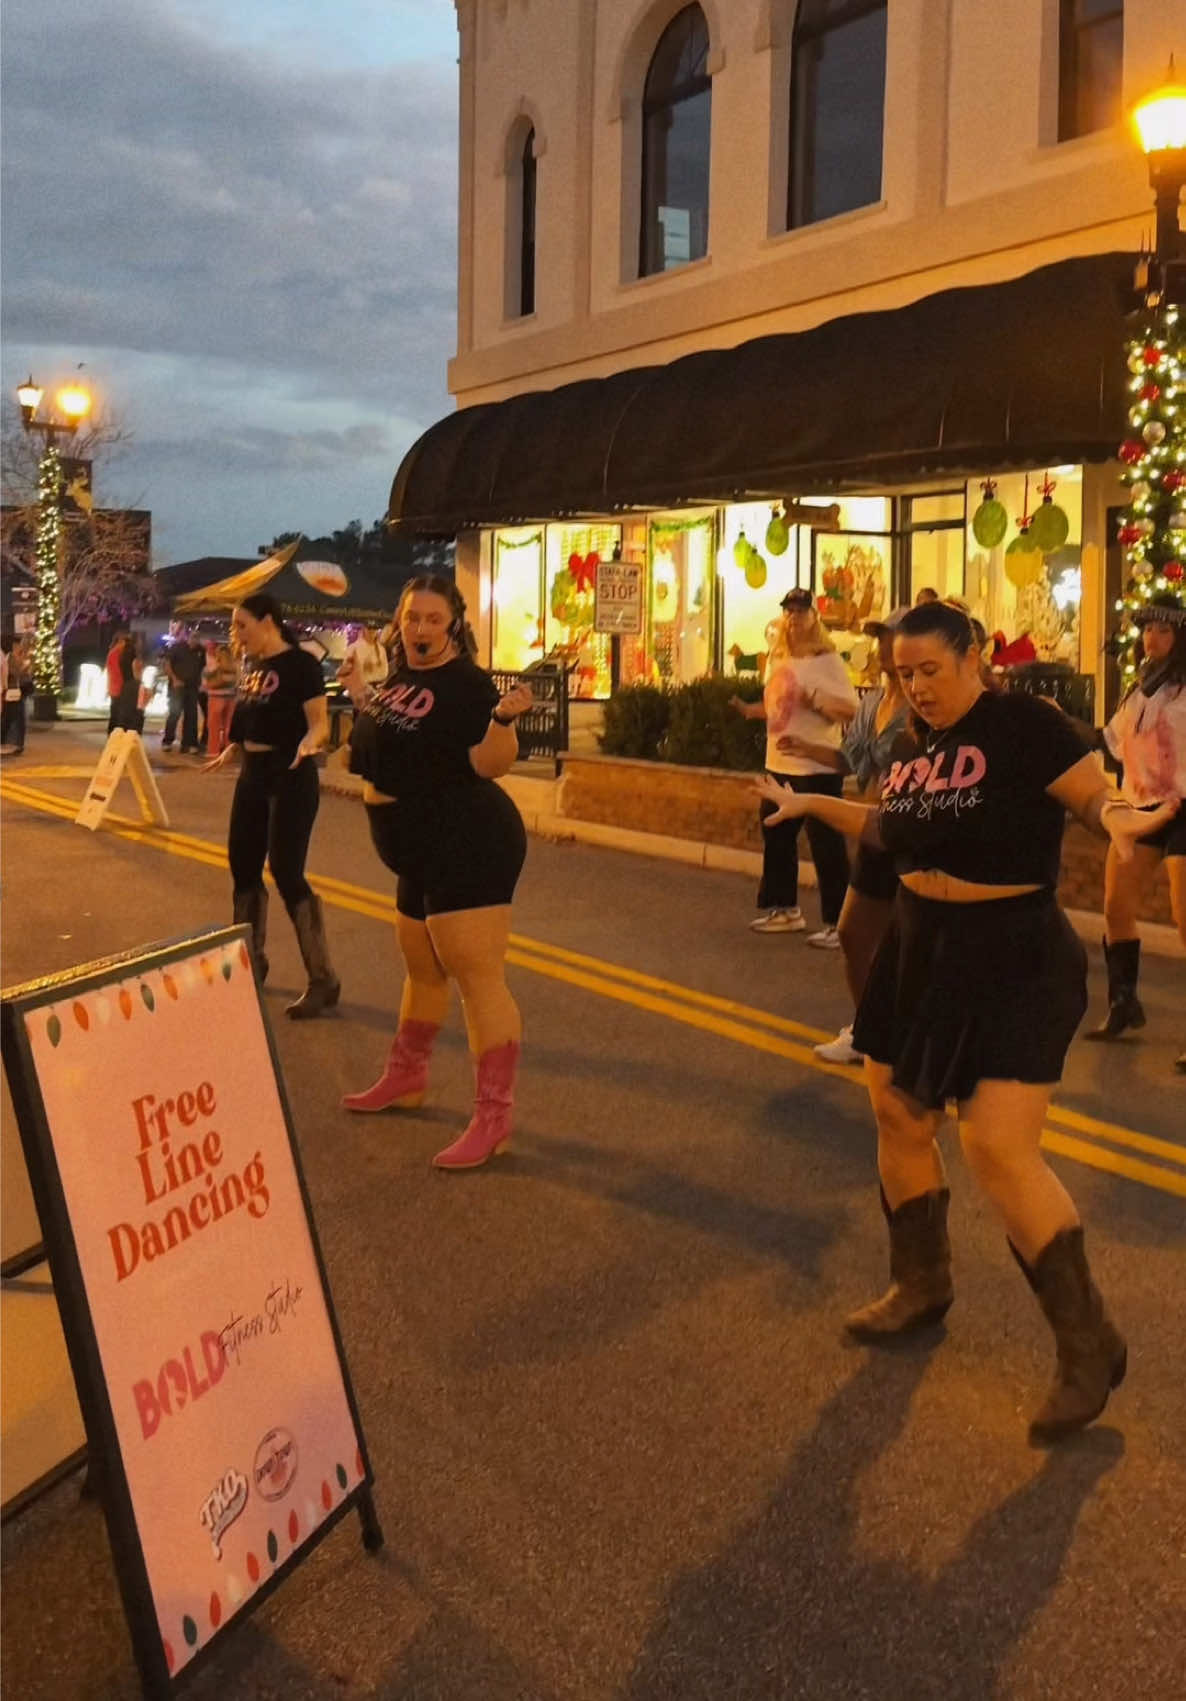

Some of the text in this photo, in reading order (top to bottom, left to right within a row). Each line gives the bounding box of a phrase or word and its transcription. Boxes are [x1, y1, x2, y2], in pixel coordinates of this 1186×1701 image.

[600, 583, 637, 600] STOP
[917, 787, 984, 820] Studio
[131, 1081, 217, 1150] Free
[135, 1130, 224, 1206] Line
[107, 1151, 270, 1284] Dancing
[133, 1330, 228, 1440] BOLD
